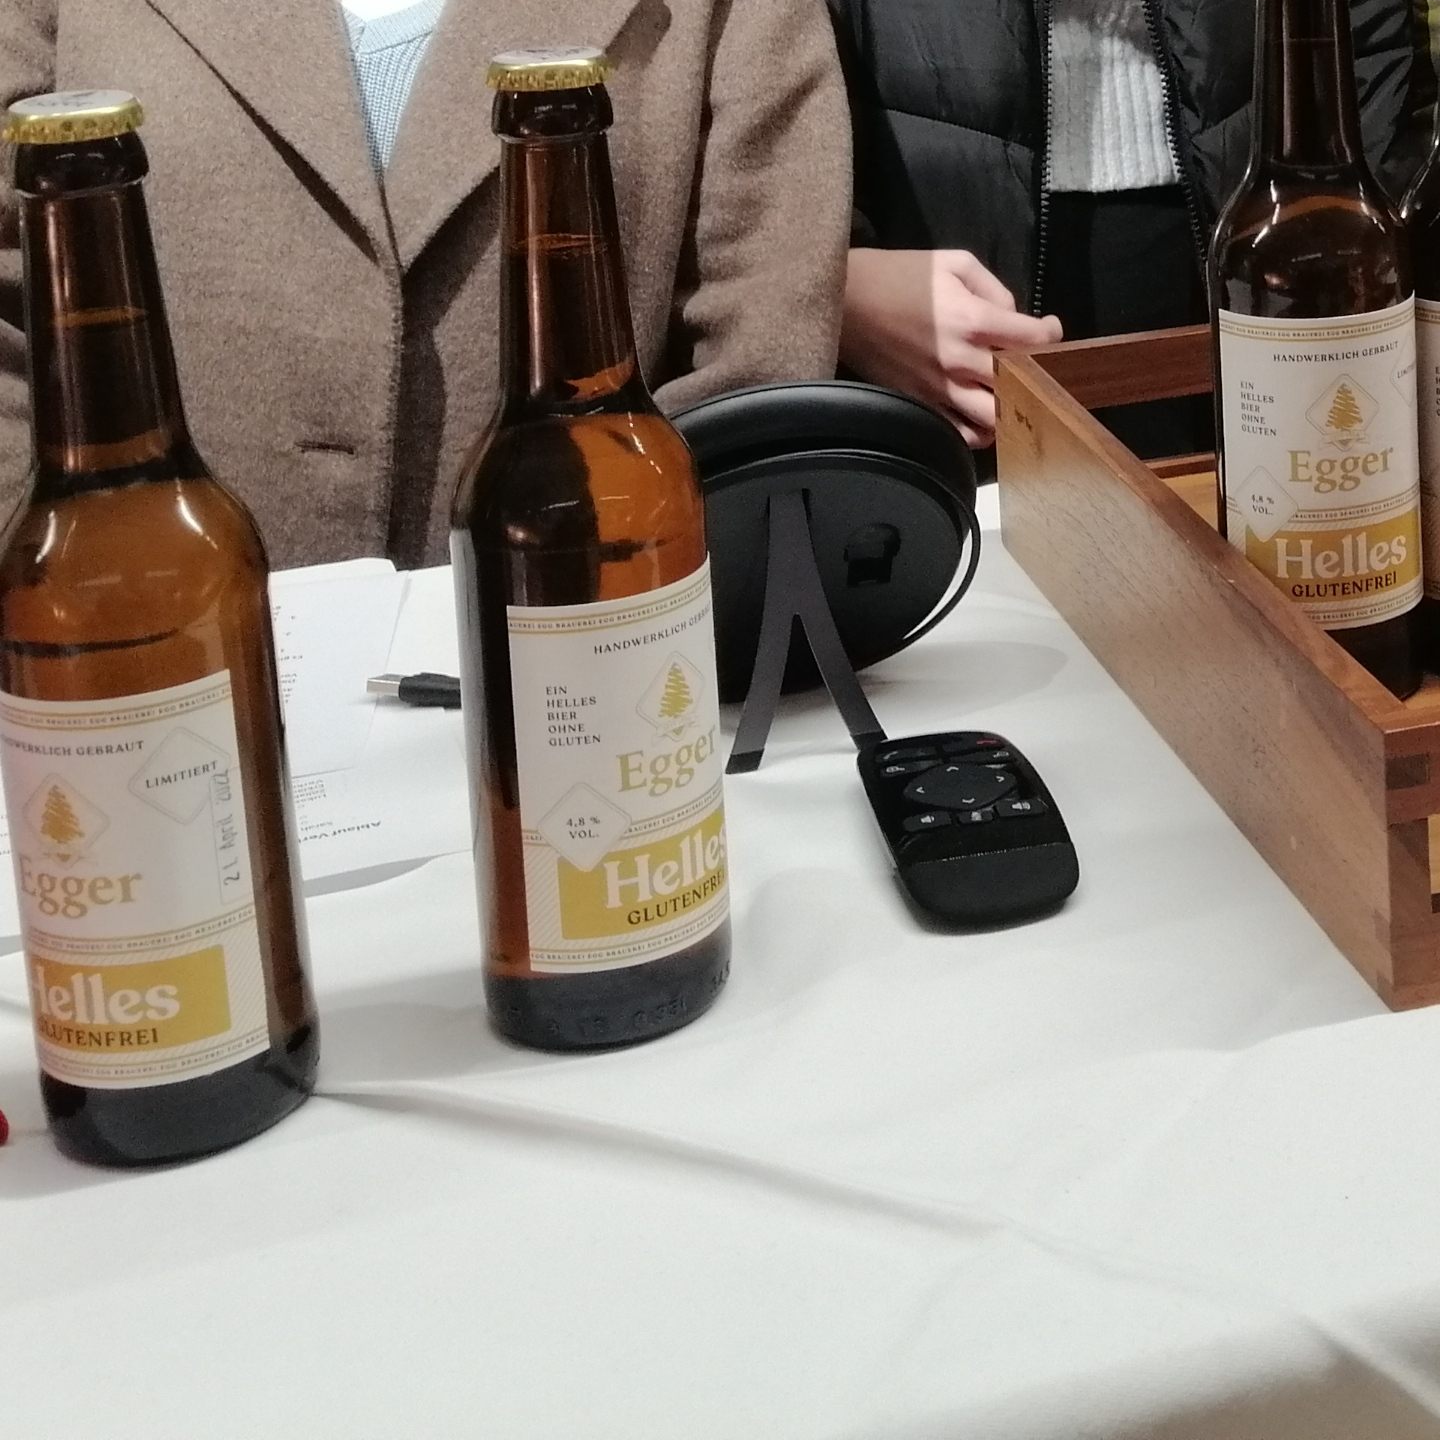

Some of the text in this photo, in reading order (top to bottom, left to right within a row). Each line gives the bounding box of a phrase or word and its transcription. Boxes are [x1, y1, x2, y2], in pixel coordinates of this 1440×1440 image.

[1273, 340, 1399, 363] HANDWERKLICH GEBRAUT
[1240, 381, 1254, 390] EIN
[1240, 392, 1275, 404] HELLES
[1240, 403, 1260, 413] BIER
[1241, 413, 1266, 425] OHNE
[1241, 424, 1277, 436] GLUTEN
[1288, 447, 1394, 494] Egger
[1275, 531, 1407, 579] Helles
[1292, 570, 1397, 598] GLUTENFREI
[594, 621, 686, 655] HANDWERKLICH
[546, 686, 567, 695] EIN
[547, 696, 597, 709] HELLES
[548, 712, 577, 721] BIER
[548, 724, 585, 734] OHNE
[549, 735, 601, 747] GLUTEN
[76, 740, 144, 756] GEBRAUT
[615, 724, 716, 797] Egger
[146, 760, 217, 789] LIMITIERT
[589, 816, 600, 825] %
[569, 830, 599, 840] VOL.
[20, 856, 143, 919] Egger
